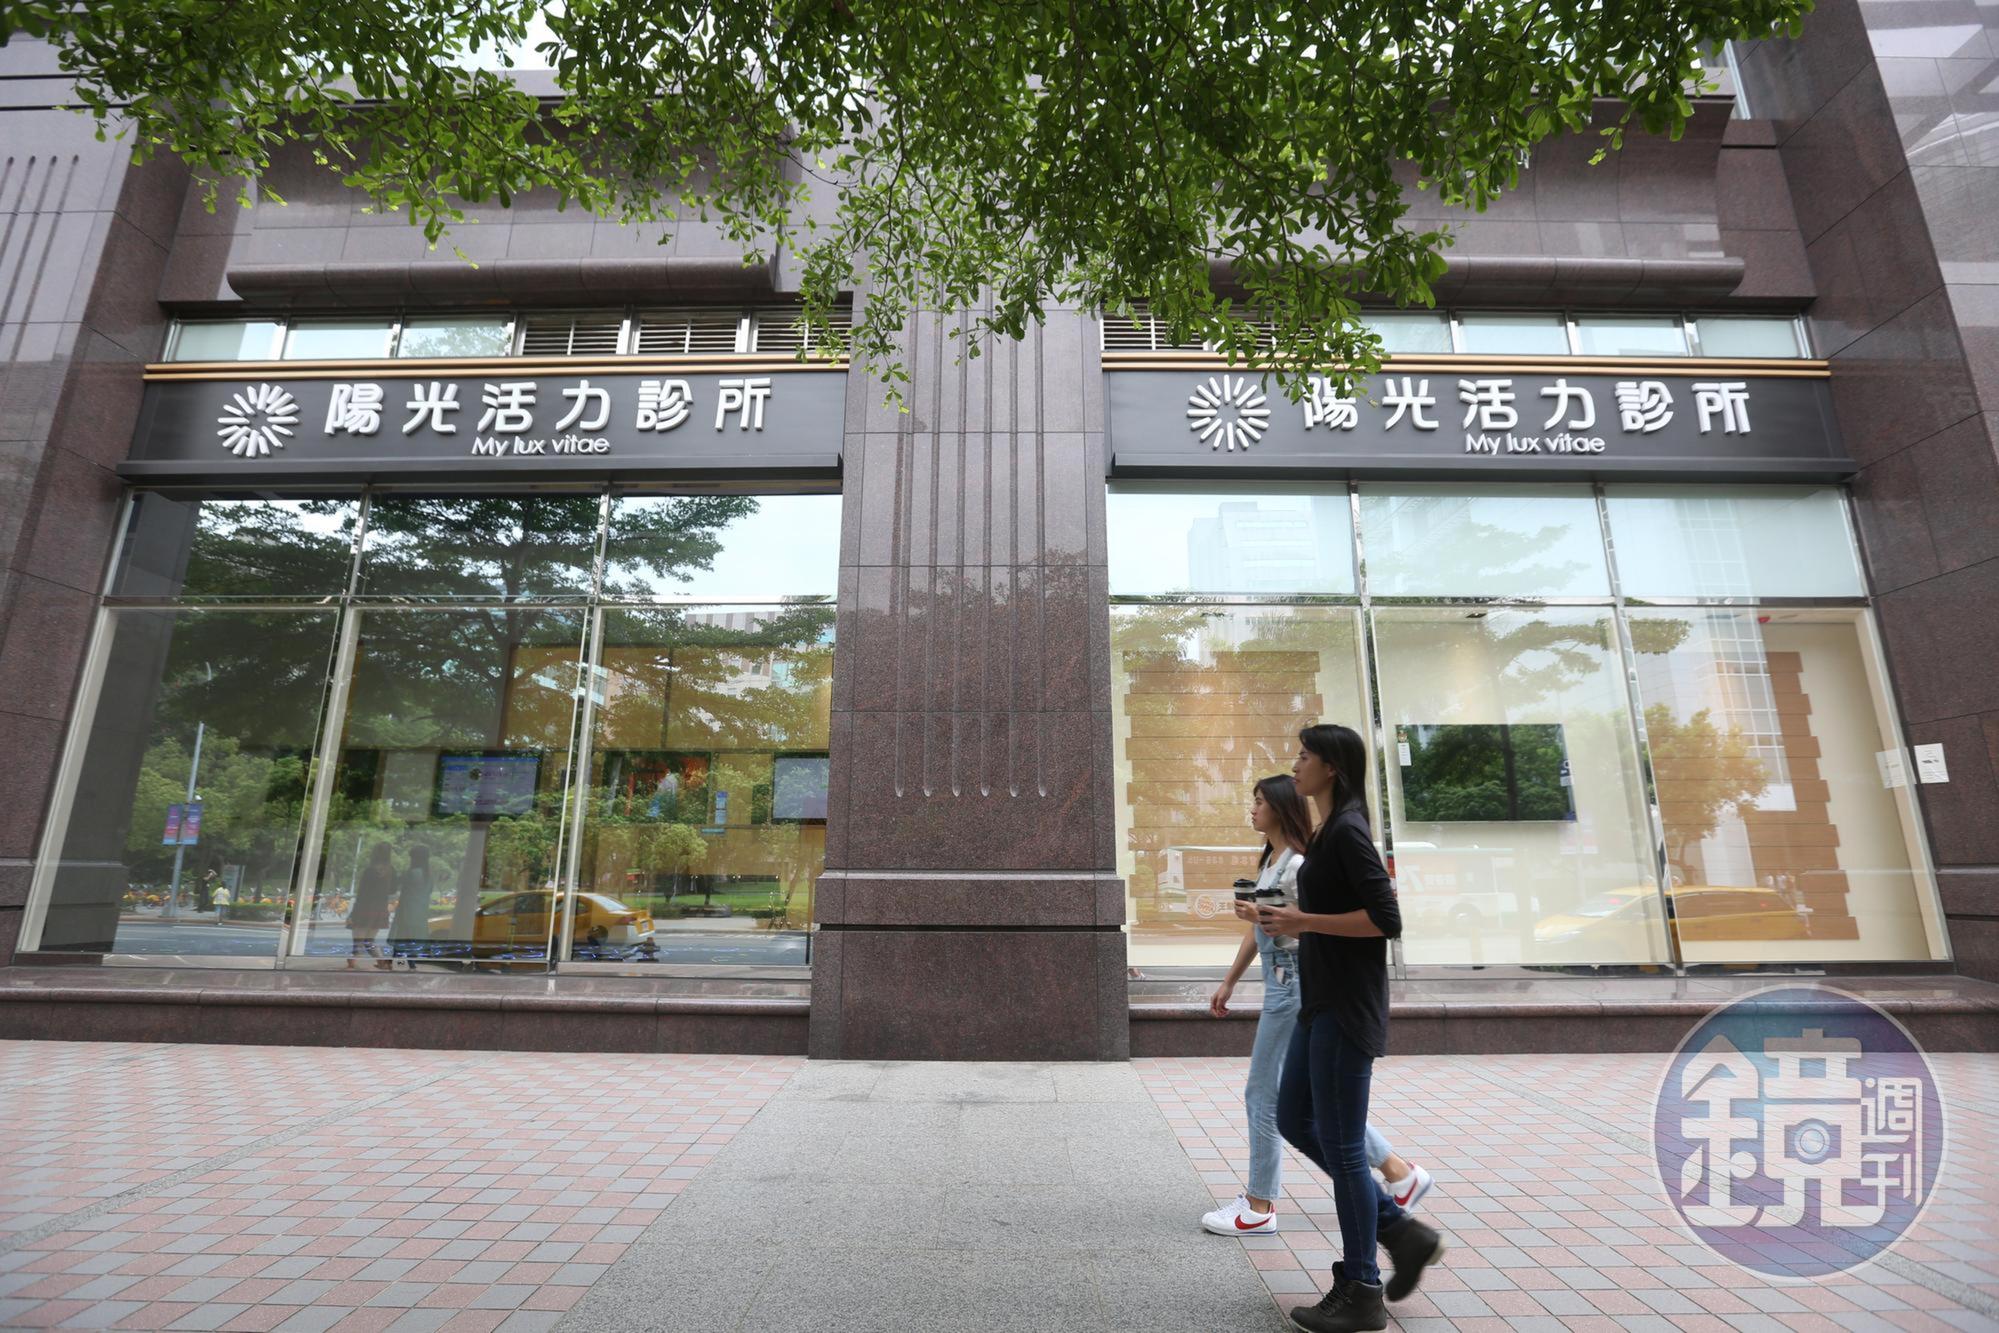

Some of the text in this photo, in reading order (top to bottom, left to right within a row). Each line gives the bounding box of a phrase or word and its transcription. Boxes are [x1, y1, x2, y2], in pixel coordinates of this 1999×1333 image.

[324, 377, 772, 434] 陽光活力診所
[1302, 377, 1752, 434] 陽光活力診所
[471, 434, 610, 457] My lux vitae
[1465, 432, 1606, 455] My lux vitae
